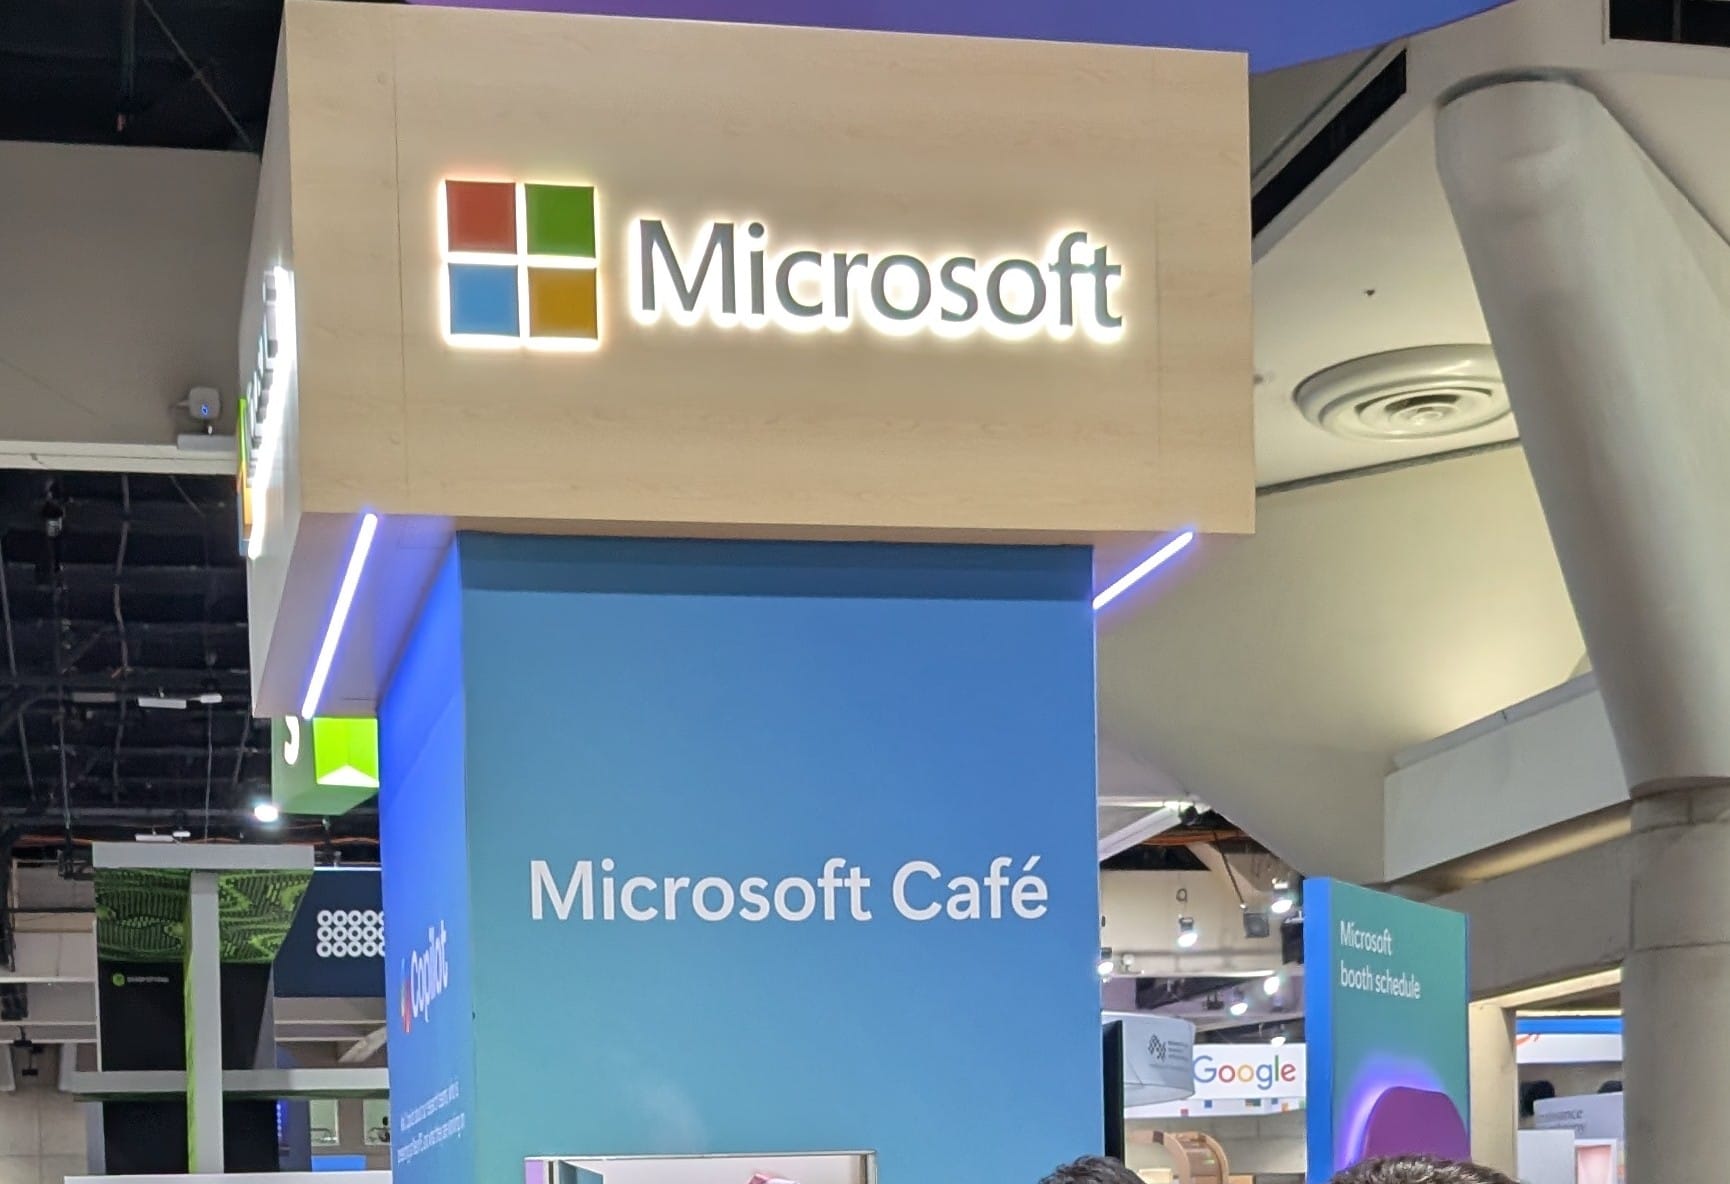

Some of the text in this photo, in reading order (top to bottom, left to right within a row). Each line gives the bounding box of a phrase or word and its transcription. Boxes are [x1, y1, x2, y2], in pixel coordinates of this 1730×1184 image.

[640, 219, 1122, 327] Microsoft
[530, 855, 1048, 921] Microsoft Café
[1340, 920, 1392, 956] Microsoft
[411, 919, 449, 1023] Copilot
[1340, 959, 1421, 999] booth schedule
[1193, 1054, 1297, 1090] Google
